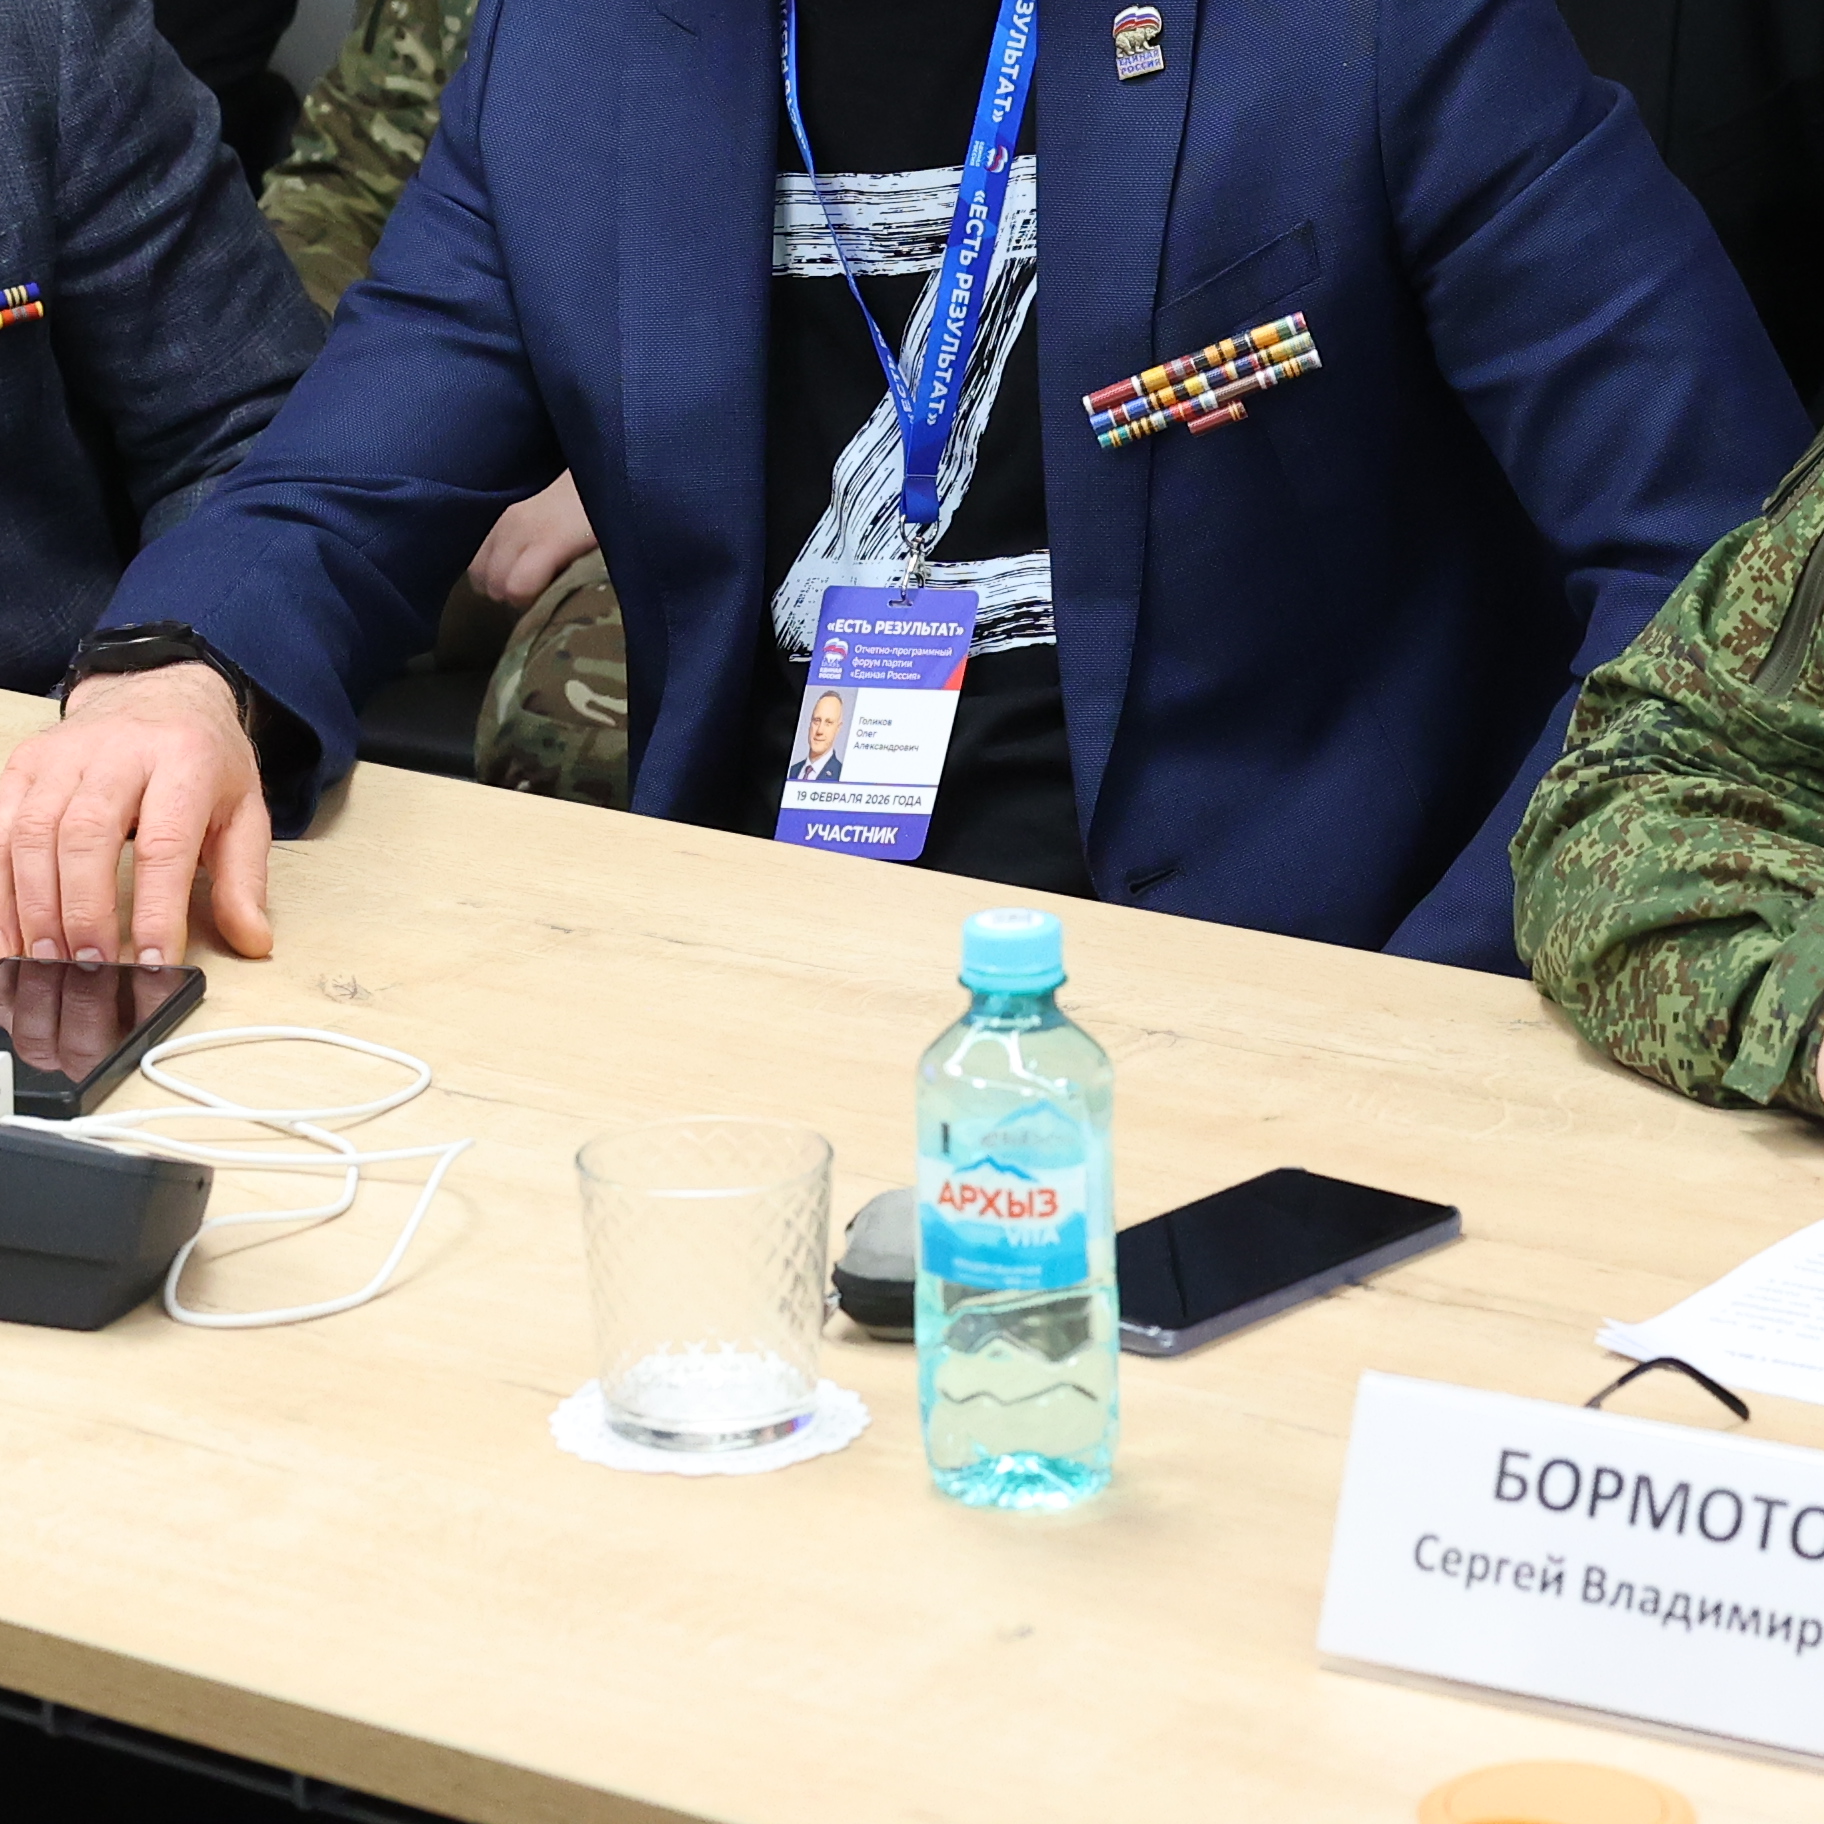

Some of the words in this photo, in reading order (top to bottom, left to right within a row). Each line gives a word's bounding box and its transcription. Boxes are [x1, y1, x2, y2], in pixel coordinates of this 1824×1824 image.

[1121, 58, 1162, 75] РОССИЯ
[959, 189, 990, 267] «ЕСТЬ
[926, 272, 975, 427] РЕЗУЛЬТАТ»
[827, 619, 872, 634] «ЕСТЬ
[874, 620, 965, 637] РЕЗУЛЬТАТ»
[854, 644, 954, 658] Отчетно-программный
[851, 657, 881, 668] форум
[881, 658, 914, 668] партии
[858, 717, 893, 726] Голиков
[856, 729, 878, 738] Олег
[853, 741, 920, 752] Александрович
[796, 790, 808, 801] 19
[809, 792, 863, 804] ФЕВРАЛЯ
[865, 794, 891, 805] 2026
[892, 795, 923, 807] ГОДА
[805, 823, 899, 844] УЧАСТНИК
[936, 1178, 1059, 1220] АРХЫЗ
[1412, 1531, 1567, 1600] Сергей
